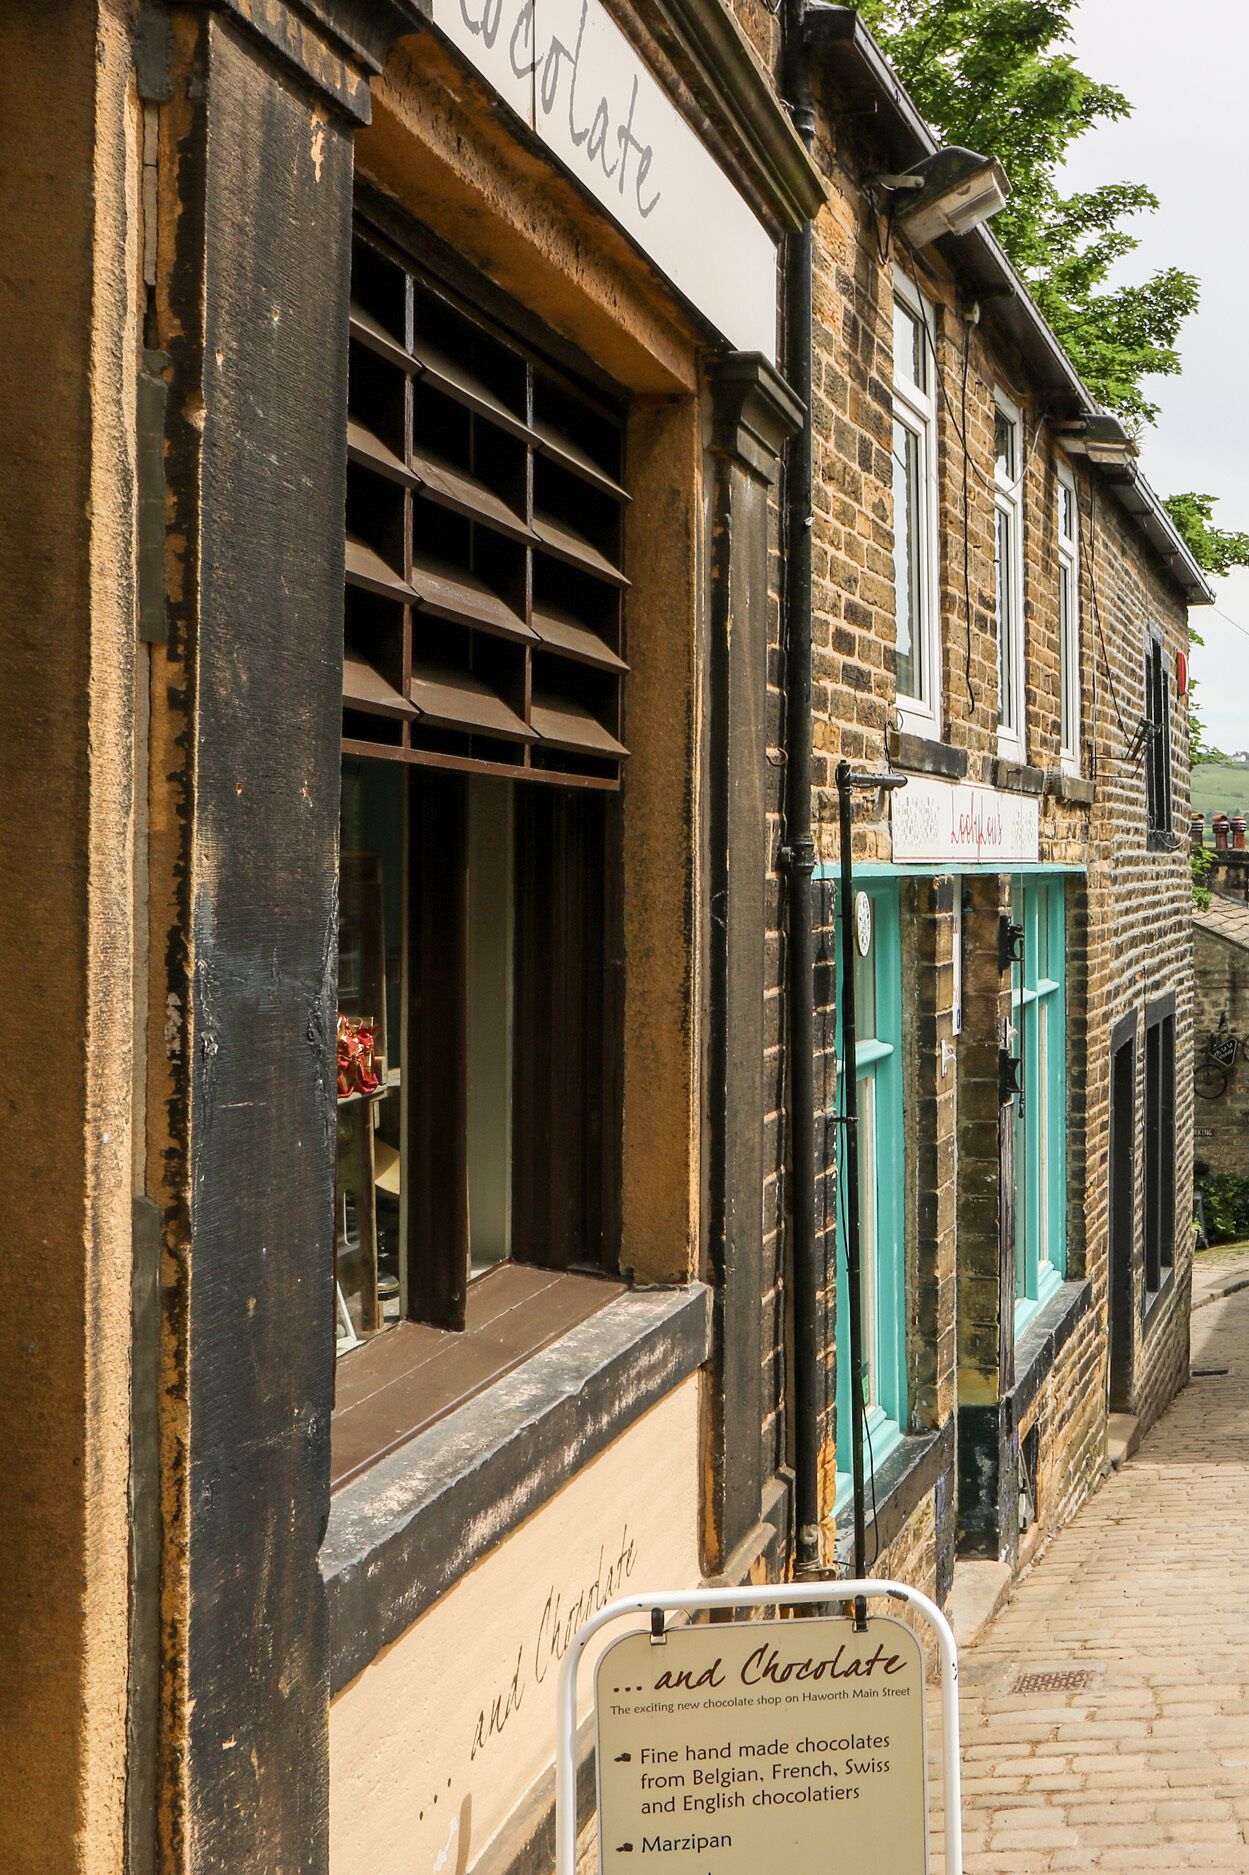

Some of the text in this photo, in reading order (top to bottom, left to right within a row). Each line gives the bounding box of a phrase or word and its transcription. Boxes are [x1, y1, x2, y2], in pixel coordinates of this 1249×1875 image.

[654, 1658, 726, 1690] and
[740, 1642, 908, 1686] Chocolate
[470, 1644, 526, 1761] and
[610, 1687, 910, 1715] The exciting new chocolate shop on Haworth Main Street
[641, 1734, 890, 1765] Fine hand made chocolates
[640, 1758, 890, 1789] from Belgian, French, Swiss
[641, 1785, 860, 1814] and English chocolatiers
[641, 1833, 732, 1854] Marzipan
